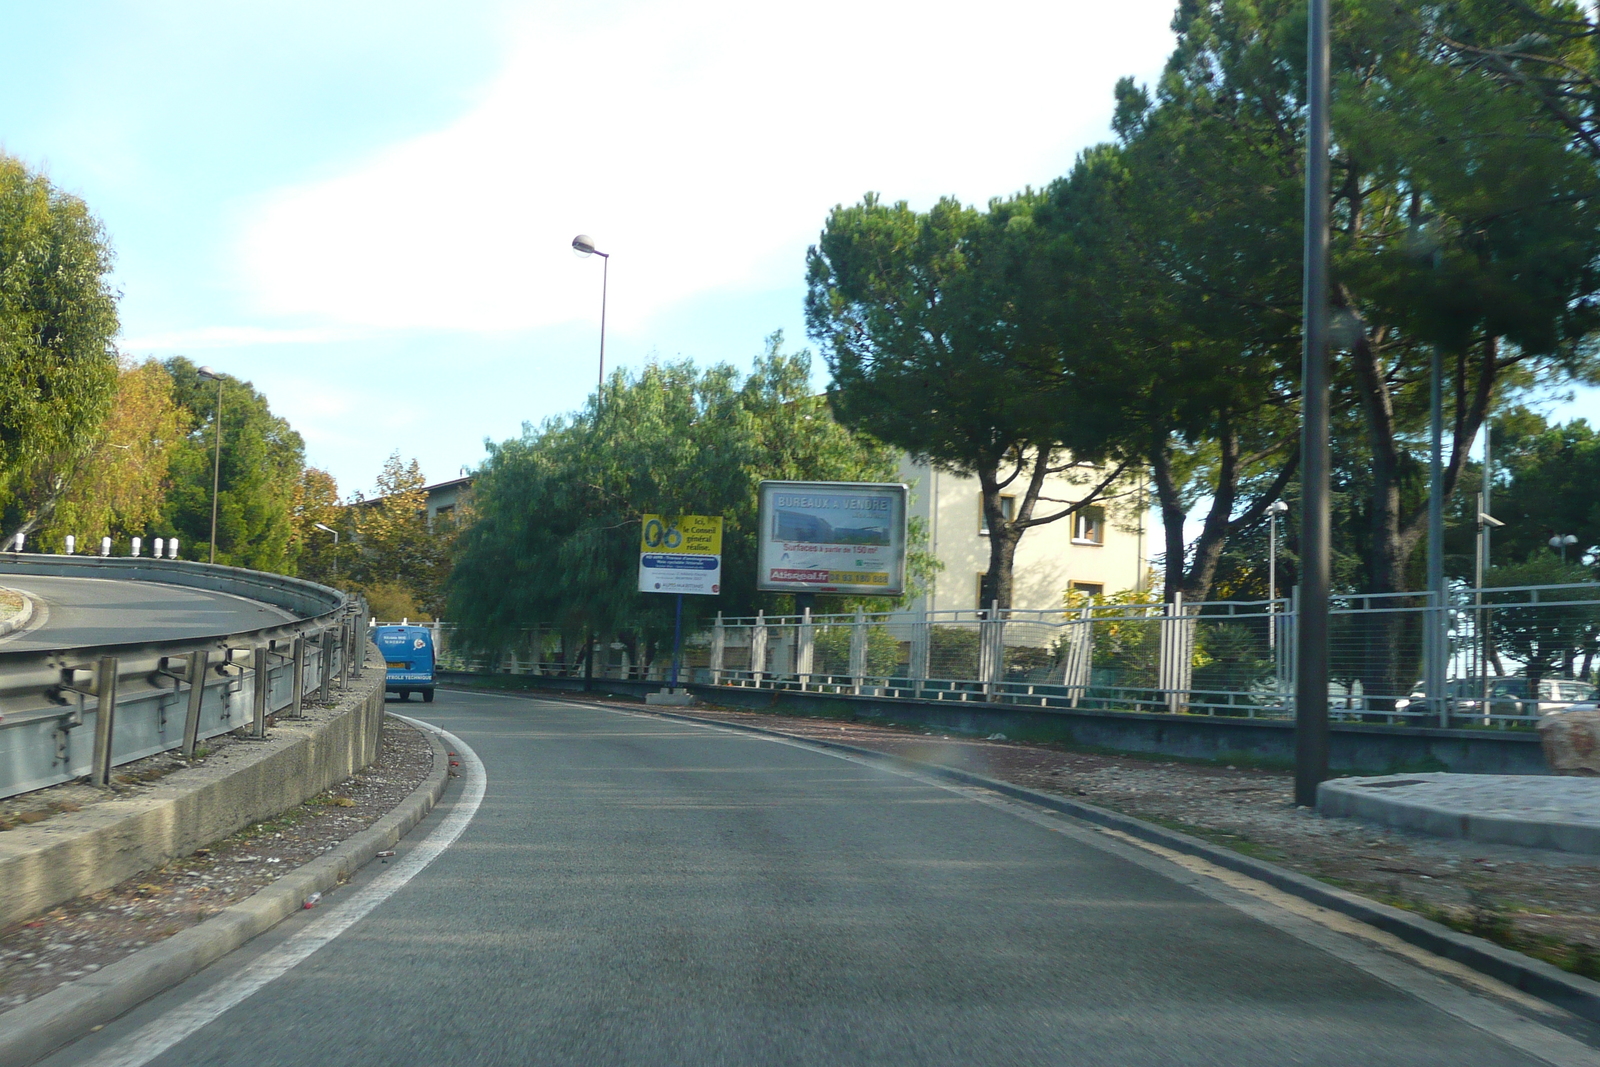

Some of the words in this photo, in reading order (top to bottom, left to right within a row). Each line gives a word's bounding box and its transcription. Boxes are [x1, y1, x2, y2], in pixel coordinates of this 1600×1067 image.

[778, 496, 830, 508] BUREAUX
[844, 499, 888, 511] VENDRE
[686, 535, 712, 543] général
[783, 543, 818, 552] Surfaces
